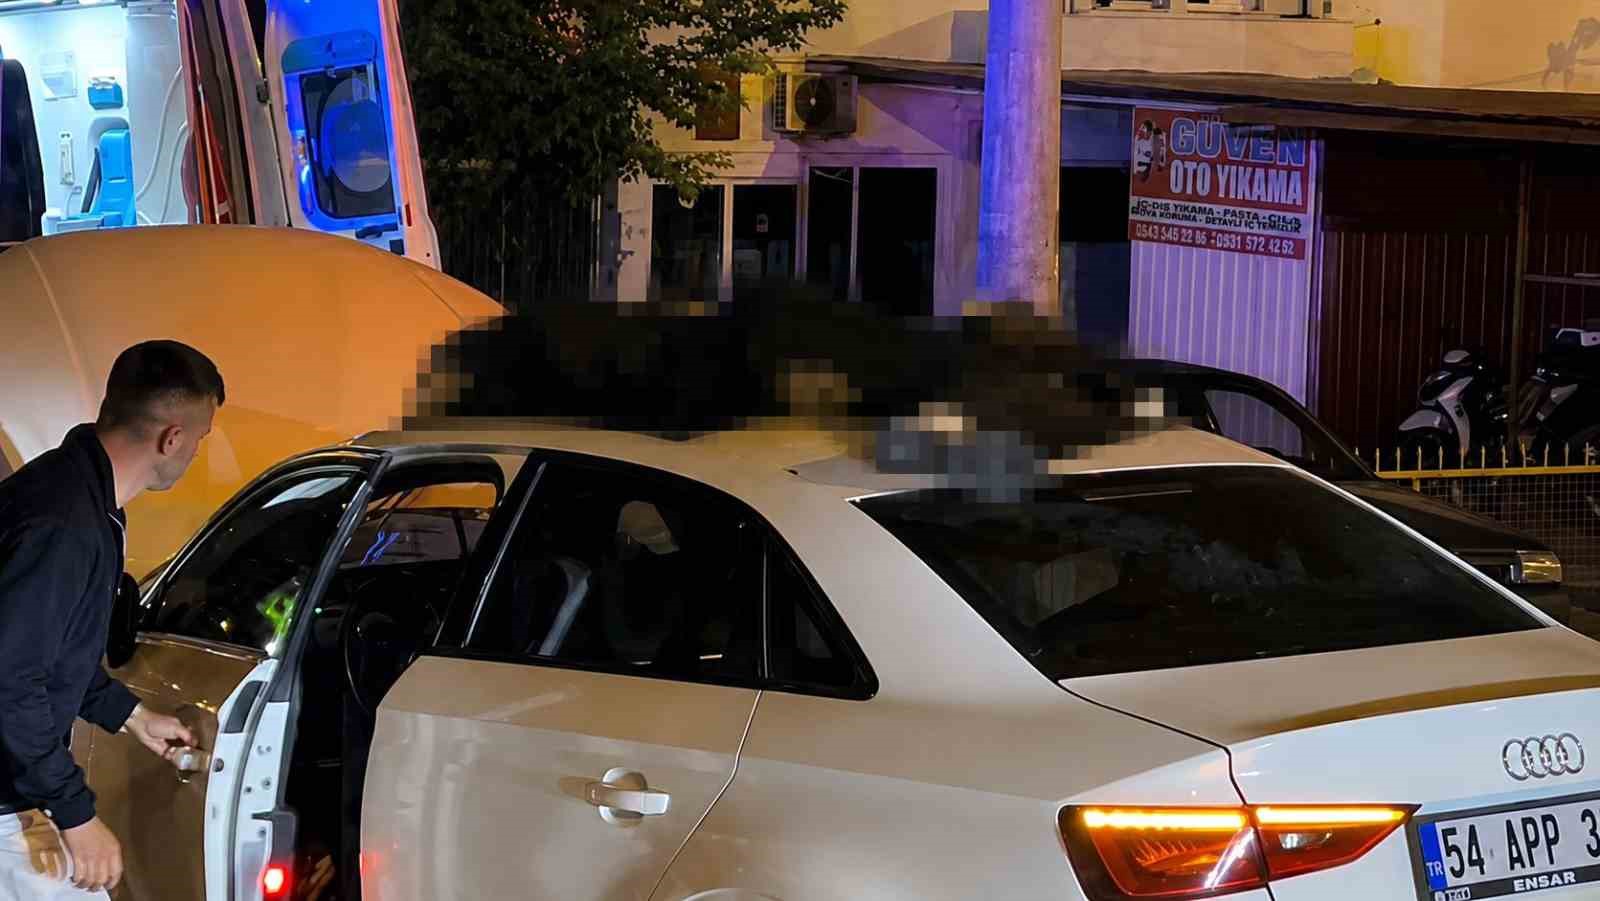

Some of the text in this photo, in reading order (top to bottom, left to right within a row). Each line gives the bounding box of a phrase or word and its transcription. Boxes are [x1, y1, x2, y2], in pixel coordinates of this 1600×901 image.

[1170, 115, 1306, 166] GÜVEN
[1170, 159, 1302, 206] OTO YIKAMA
[1159, 211, 1198, 223] KORUMA
[1173, 203, 1214, 217] YIKAMA
[1223, 208, 1259, 221] PASTA
[1246, 236, 1265, 252] 572
[1441, 824, 1485, 879] 54
[1505, 813, 1560, 871] APP
[1426, 861, 1444, 877] TR
[1513, 871, 1576, 892] ENSAR
